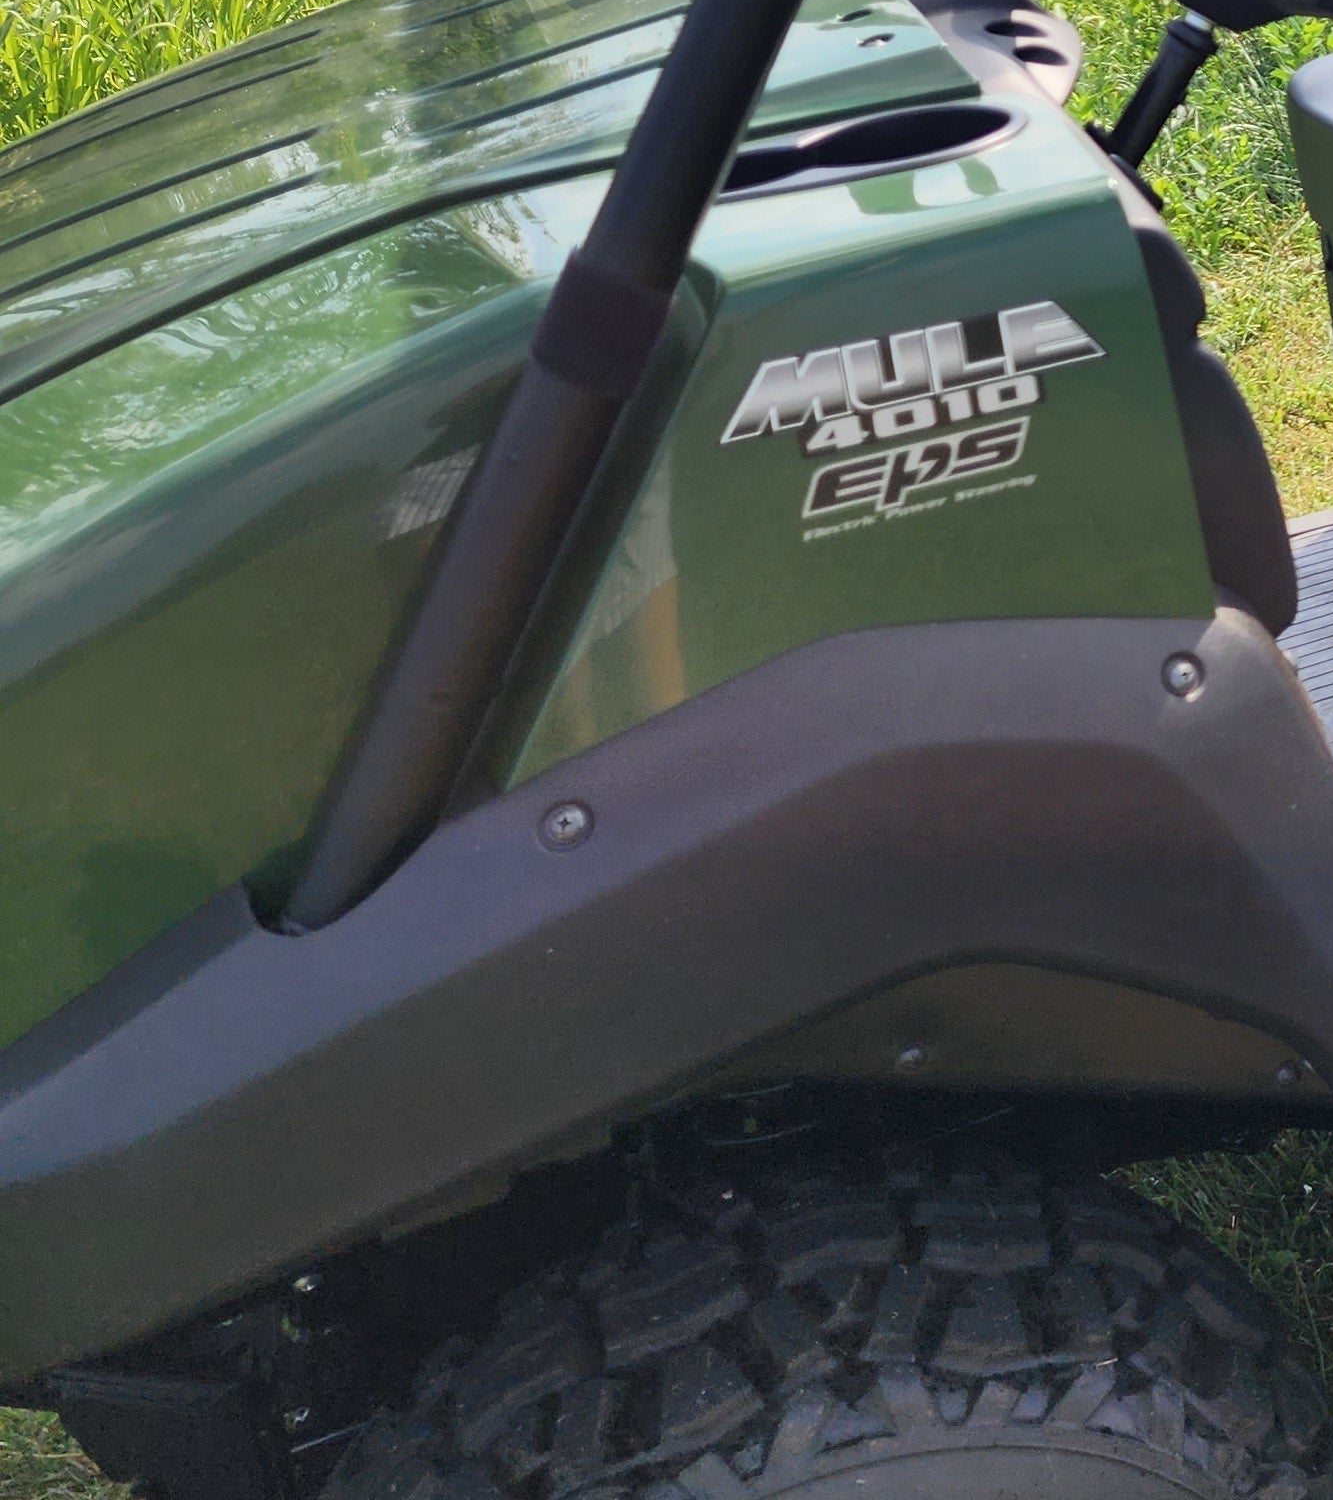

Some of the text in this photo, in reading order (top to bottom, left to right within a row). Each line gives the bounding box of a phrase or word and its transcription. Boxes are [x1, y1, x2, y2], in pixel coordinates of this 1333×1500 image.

[720, 300, 1107, 445] MULE
[806, 374, 1041, 453] 4010
[802, 415, 1031, 519] EPS
